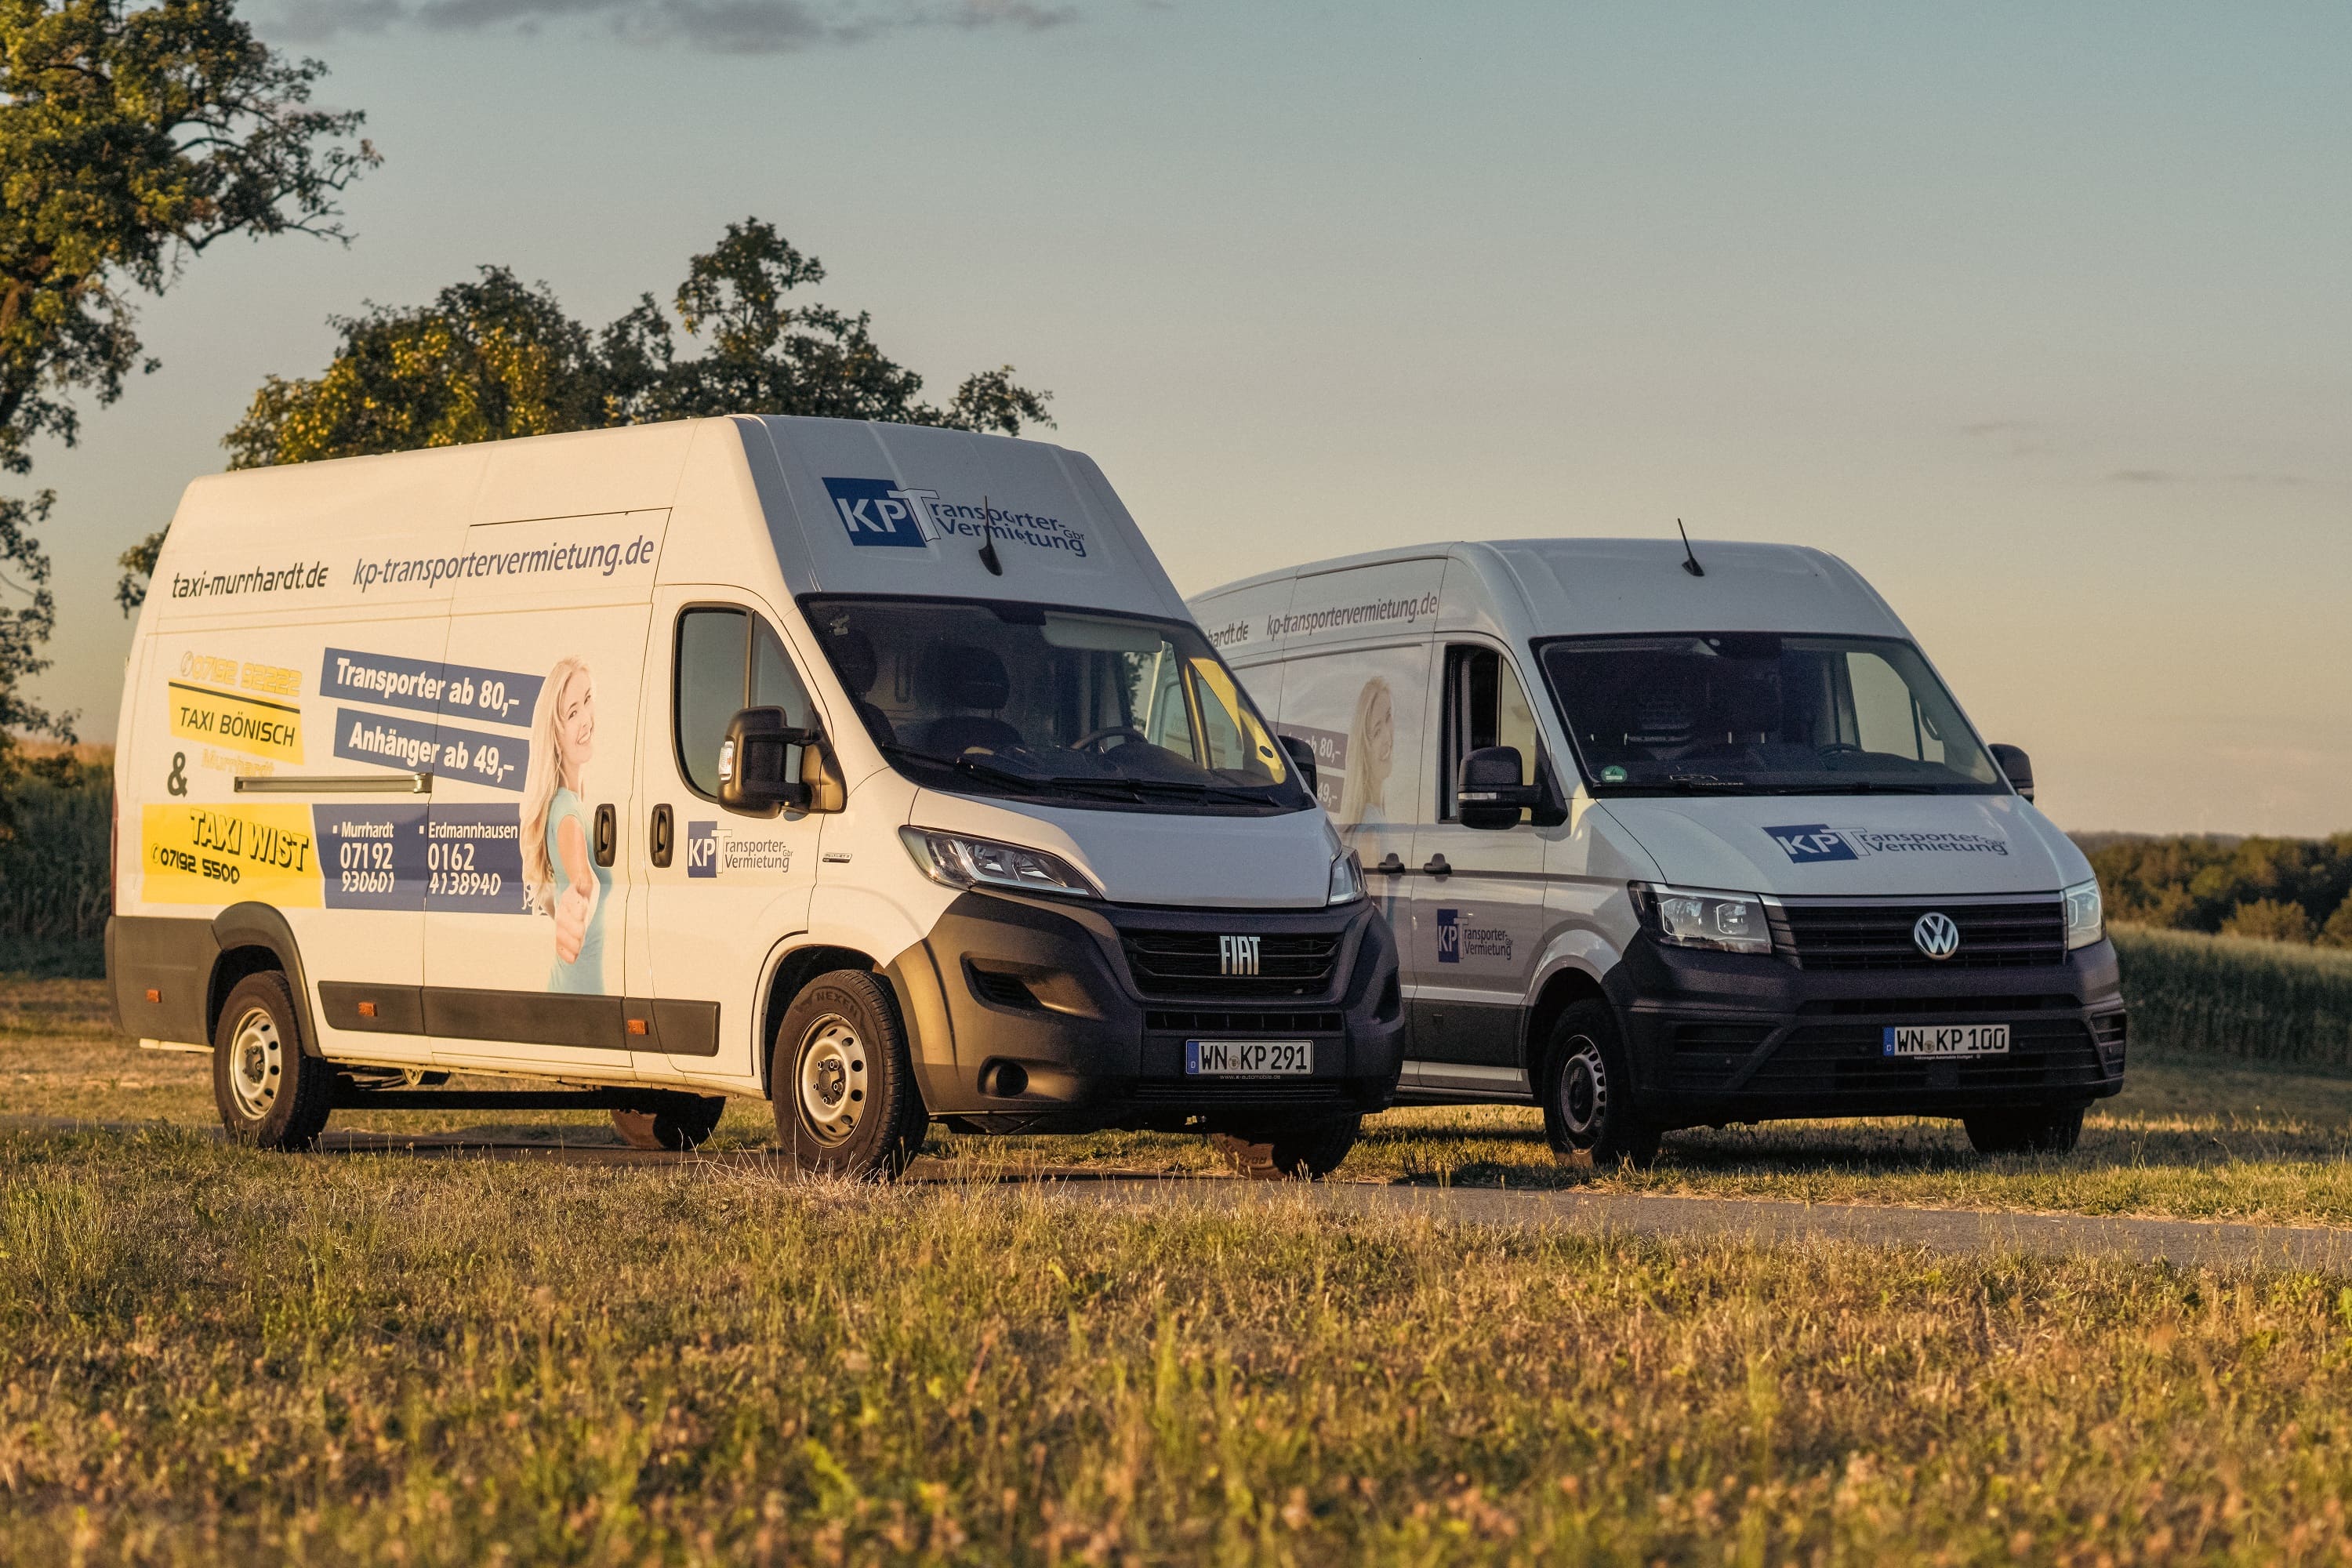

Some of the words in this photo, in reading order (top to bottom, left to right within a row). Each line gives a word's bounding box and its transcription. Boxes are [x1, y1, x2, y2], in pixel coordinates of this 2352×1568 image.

[171, 560, 328, 599] taxi-murrhardt.de
[353, 535, 655, 593] kp-transportervermietung.de
[1266, 592, 1438, 642] kp-transportervermietung.de
[192, 655, 238, 685] 07192
[336, 657, 447, 699] Transporter
[448, 677, 474, 706] ab
[181, 707, 215, 732] TAXI
[220, 711, 296, 747] BÖNISCH
[349, 721, 441, 767] Anhänger
[444, 741, 469, 770] ab
[167, 751, 188, 798] &
[190, 808, 242, 855] TAXI
[249, 822, 309, 873] WIST
[341, 822, 394, 839] Murrhardt
[428, 822, 519, 840] Erdmannhausen
[339, 843, 394, 869] 07192
[427, 843, 475, 872] 0162
[724, 853, 789, 873] Vermietung
[1867, 841, 2009, 856] Vermietung
[160, 848, 198, 873] 07192
[202, 858, 241, 884] 5500
[341, 870, 395, 893] 930601
[429, 873, 502, 896] 4138940
[1219, 935, 1261, 975] FIAT
[1465, 942, 1512, 960] Vermietung
[816, 991, 858, 1018] NEXEN
[1896, 1029, 1923, 1052] WN
[1936, 1029, 1962, 1051] KP
[1968, 1028, 2005, 1051] 100
[1201, 1045, 1228, 1070] WN
[1240, 1045, 1267, 1070] KP
[1271, 1045, 1308, 1070] 291
